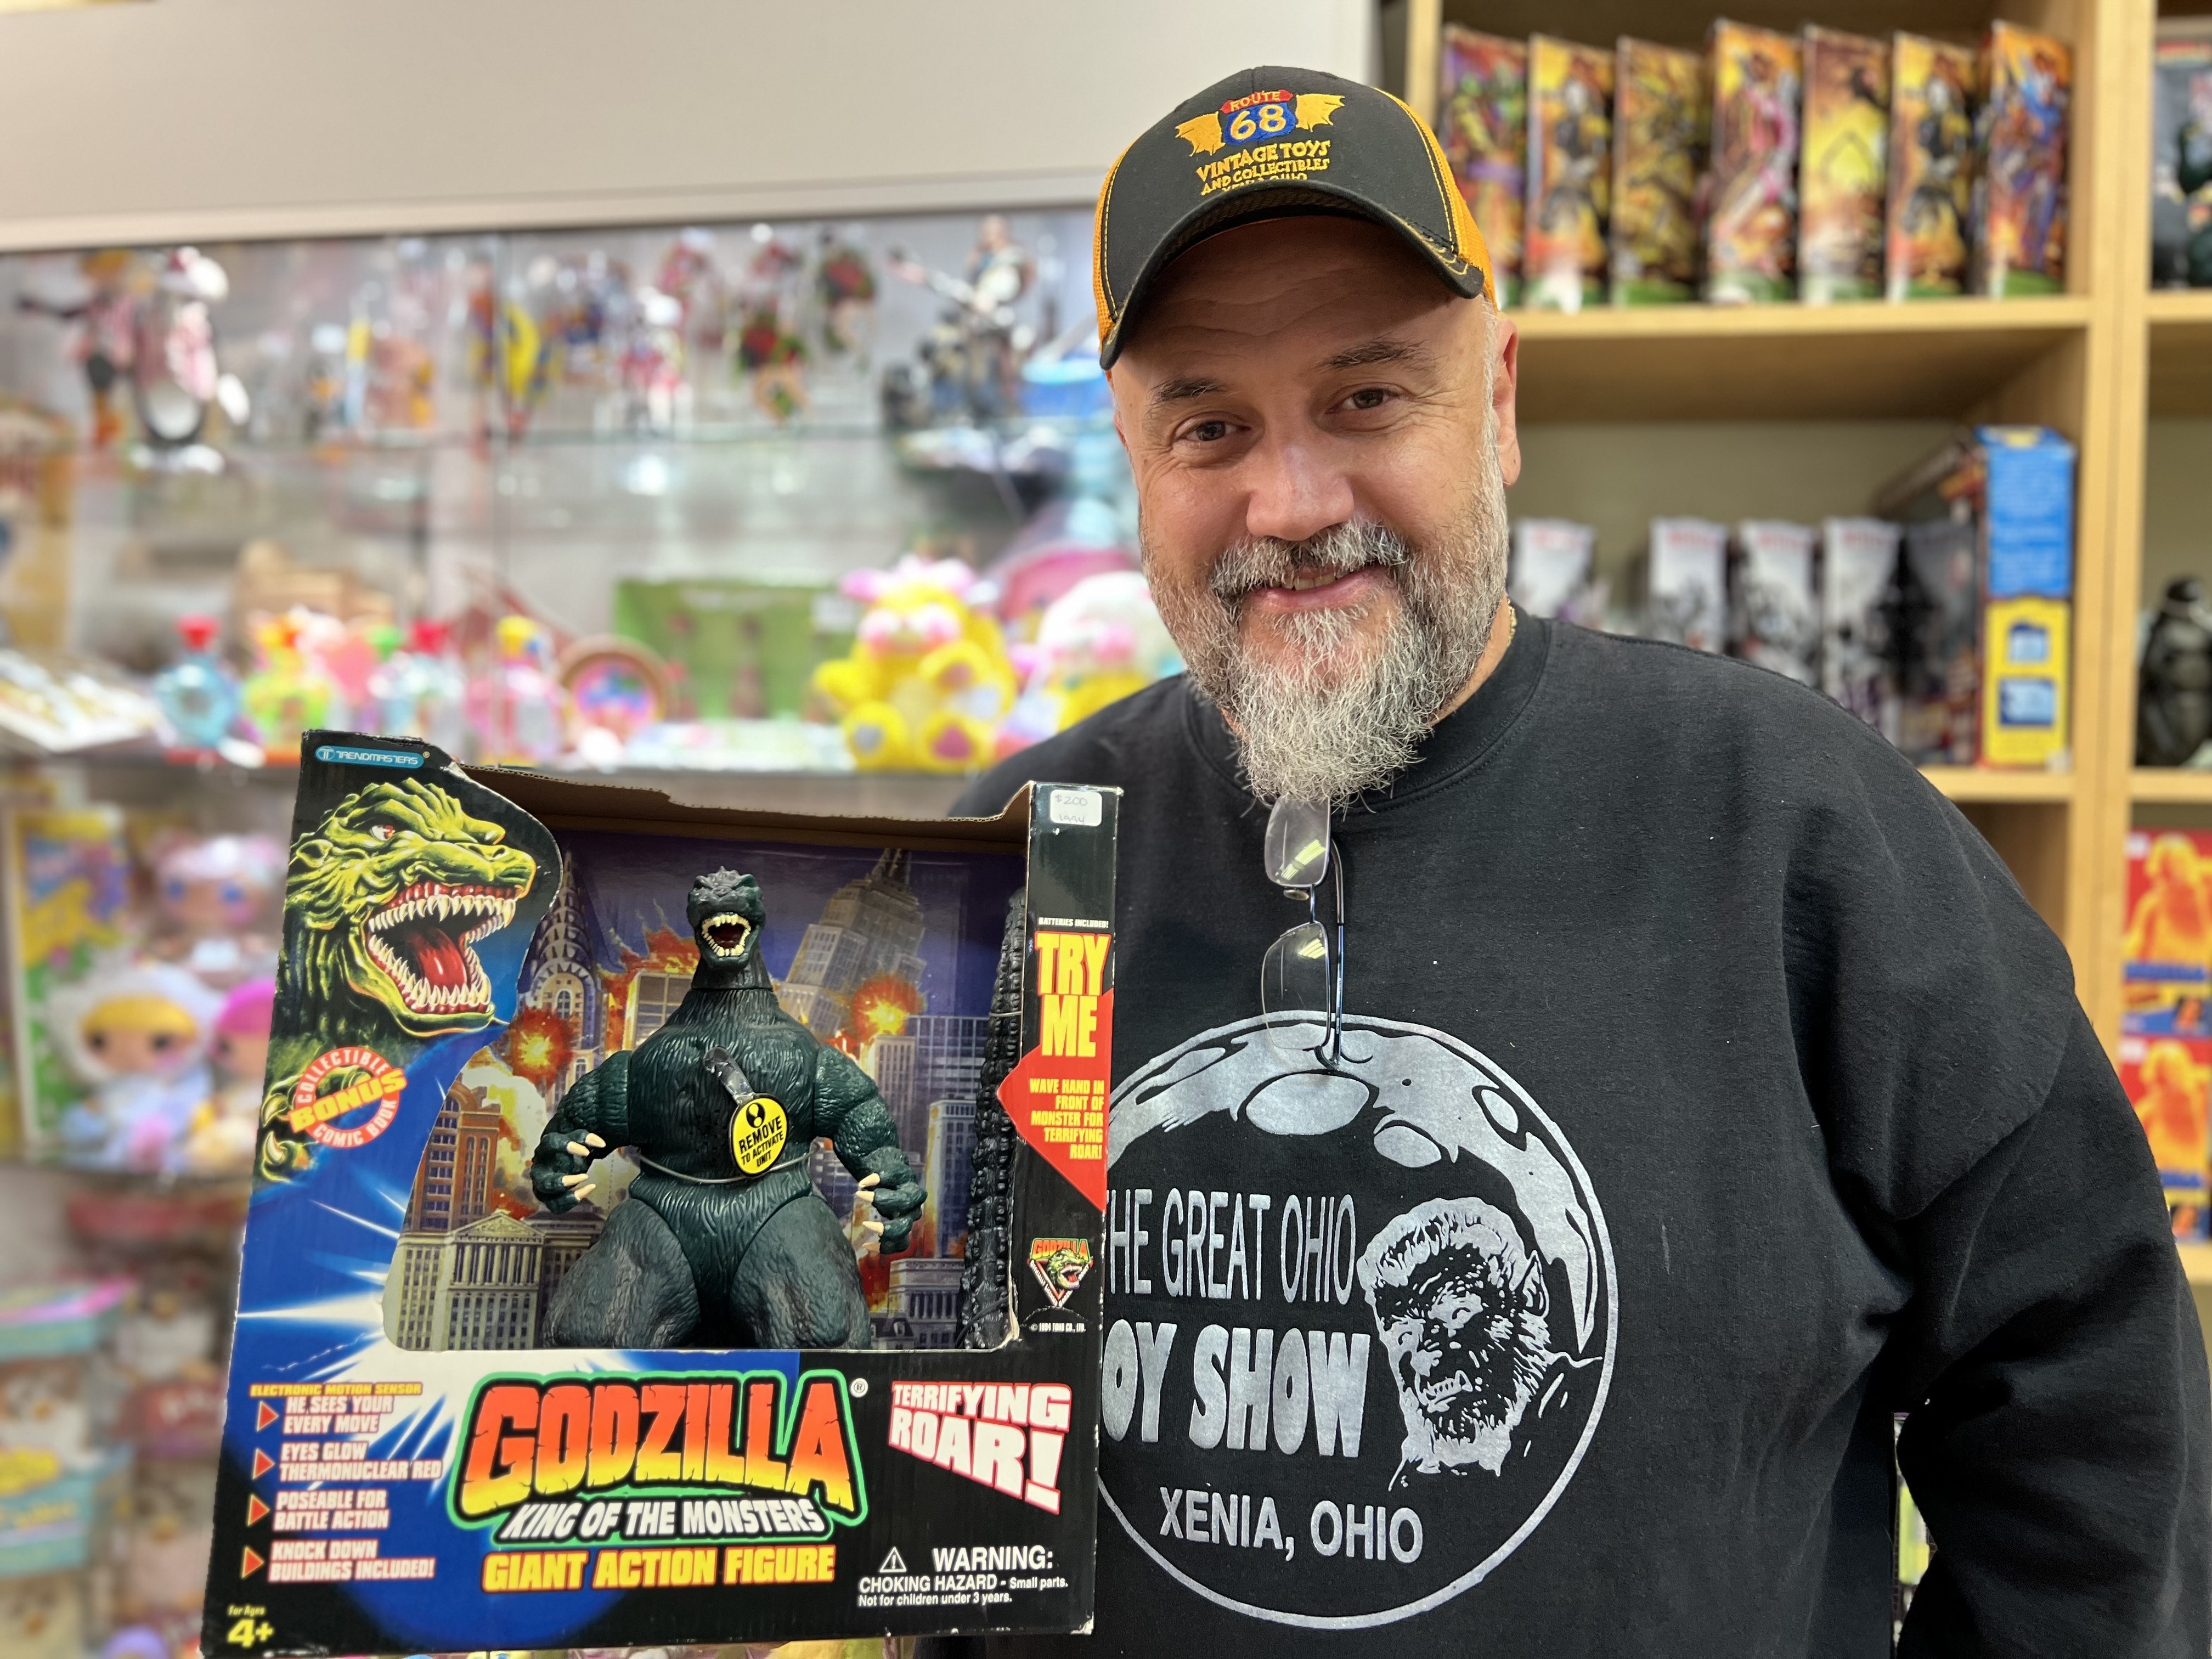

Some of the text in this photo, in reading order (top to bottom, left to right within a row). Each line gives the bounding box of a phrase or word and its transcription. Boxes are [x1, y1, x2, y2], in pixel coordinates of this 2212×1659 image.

[1230, 91, 1281, 111] ROUTE
[1231, 104, 1286, 140] 68
[1196, 140, 1331, 182] VINTAGE TOYS
[1201, 176, 1231, 196] AND
[1233, 158, 1330, 182] COLLECTIBLES
[335, 751, 418, 765] TRENDMASTERS
[1054, 794, 1088, 806] $200
[1059, 814, 1086, 825] 1994
[1039, 917, 1109, 929] BATTERIES INCLUDED!
[1036, 933, 1110, 996] TRY
[1042, 995, 1098, 1057] ME
[297, 1049, 390, 1104] COLLECTIBLE
[1029, 1078, 1105, 1094] WAVE HAND IN
[289, 1069, 407, 1132] BONUS
[1055, 1095, 1104, 1111] FRONT OF
[313, 1099, 397, 1146] COMIC BOOK
[1031, 1110, 1104, 1127] MONSTER FOR
[738, 1115, 783, 1154] REMOVE
[1044, 1127, 1103, 1143] TERRIFYING
[741, 1130, 784, 1166] TO ACTIVATE
[756, 1150, 772, 1167] UNIT
[1069, 1144, 1102, 1160] ROAR!
[1107, 1188, 1152, 1294] HE
[1163, 1188, 1271, 1301] GREAT
[1280, 1194, 1356, 1305] OHIO
[250, 1383, 422, 1396] ELECTRONIC MOTION SENSOR
[1102, 1319, 1371, 1458] OY SHOW
[286, 1396, 394, 1414] HE SEES YOUR
[893, 1383, 1071, 1431] TERRIFYING
[284, 1414, 380, 1434] EVERY MOVE
[281, 1441, 369, 1462] EYES GLOW
[461, 1383, 855, 1515] GODZILLA
[280, 1460, 442, 1481] THERMONUCLEAR RED
[889, 1408, 1064, 1515] ROAR!
[277, 1489, 387, 1510] POSEABLE FOR
[273, 1509, 390, 1531] BATTLE ACTION
[504, 1499, 826, 1538] KING OF THE MONSTERS
[1159, 1486, 1424, 1564] XENIA, OHIO
[271, 1539, 379, 1561] KNOCK DOWN
[932, 1545, 1053, 1572] WARNING:
[268, 1558, 436, 1582] BUILDINGS INCLUDED!
[484, 1545, 835, 1591] GIANT ACTION FIGURE
[859, 1575, 930, 1593] CHOKING
[934, 1573, 997, 1591] HAZARD
[1009, 1576, 1038, 1589] Small
[1040, 1576, 1068, 1591] parts.
[858, 1592, 1012, 1607] Not for children under 3 years.
[228, 1605, 266, 1617] For Ages
[227, 1619, 273, 1647] 4+
